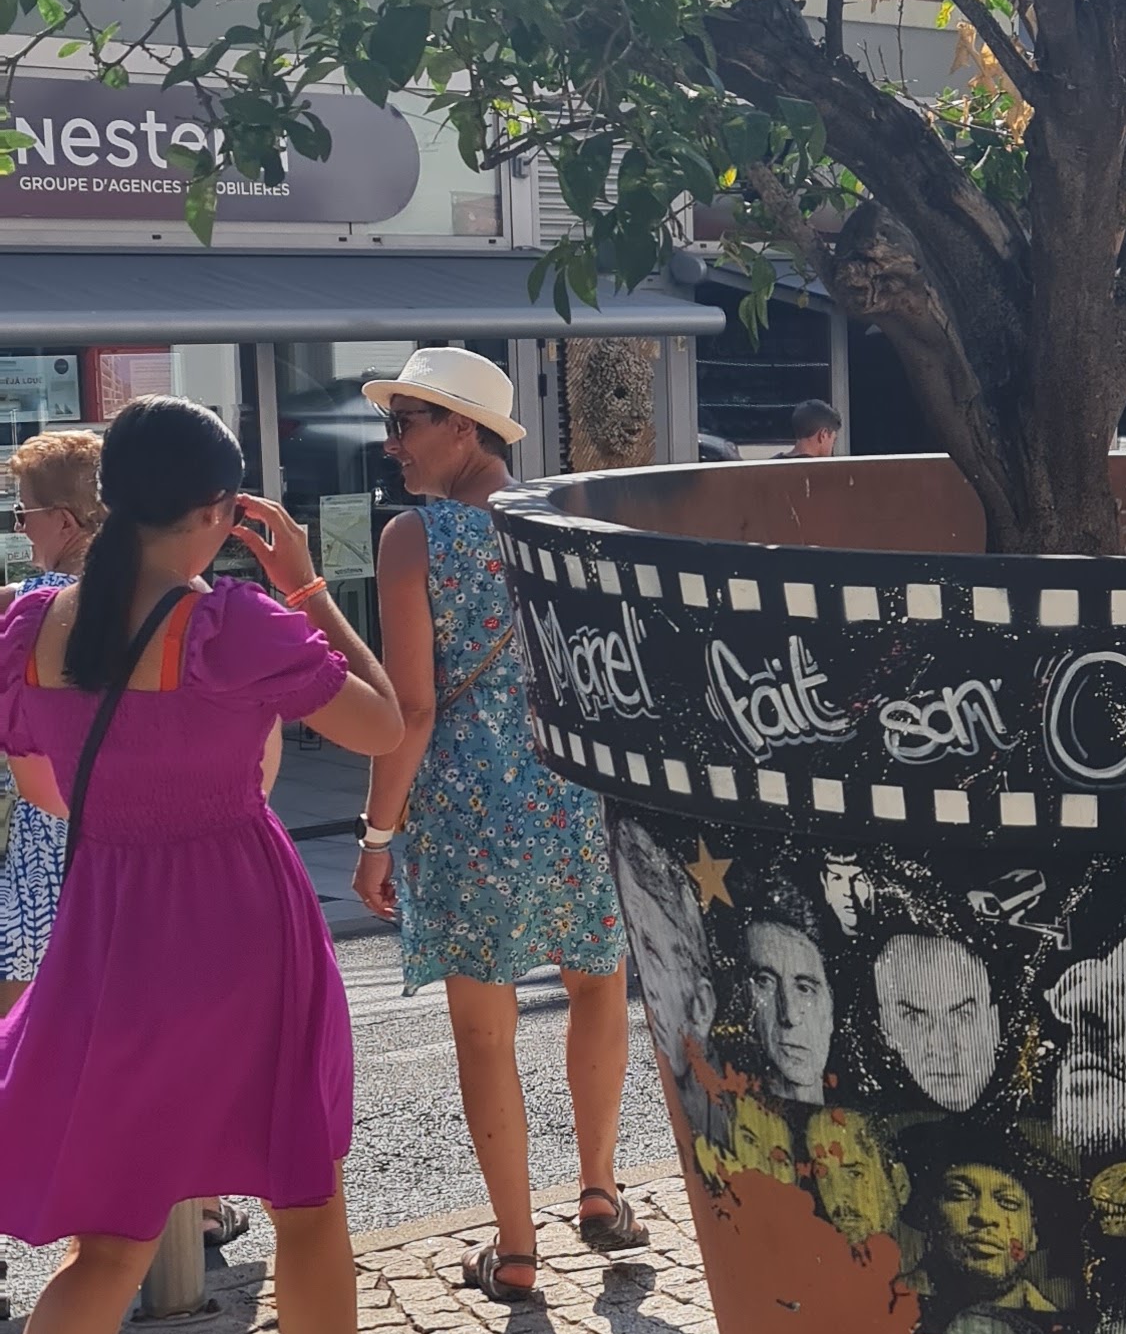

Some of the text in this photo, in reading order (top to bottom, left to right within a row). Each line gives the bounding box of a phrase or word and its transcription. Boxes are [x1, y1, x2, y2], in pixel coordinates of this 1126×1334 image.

[15, 110, 289, 172] Neste
[20, 177, 89, 192] GROUPE
[93, 178, 182, 194] D'AGENCES
[528, 600, 655, 717] Morel
[708, 635, 850, 753] fait
[879, 679, 1007, 750] son
